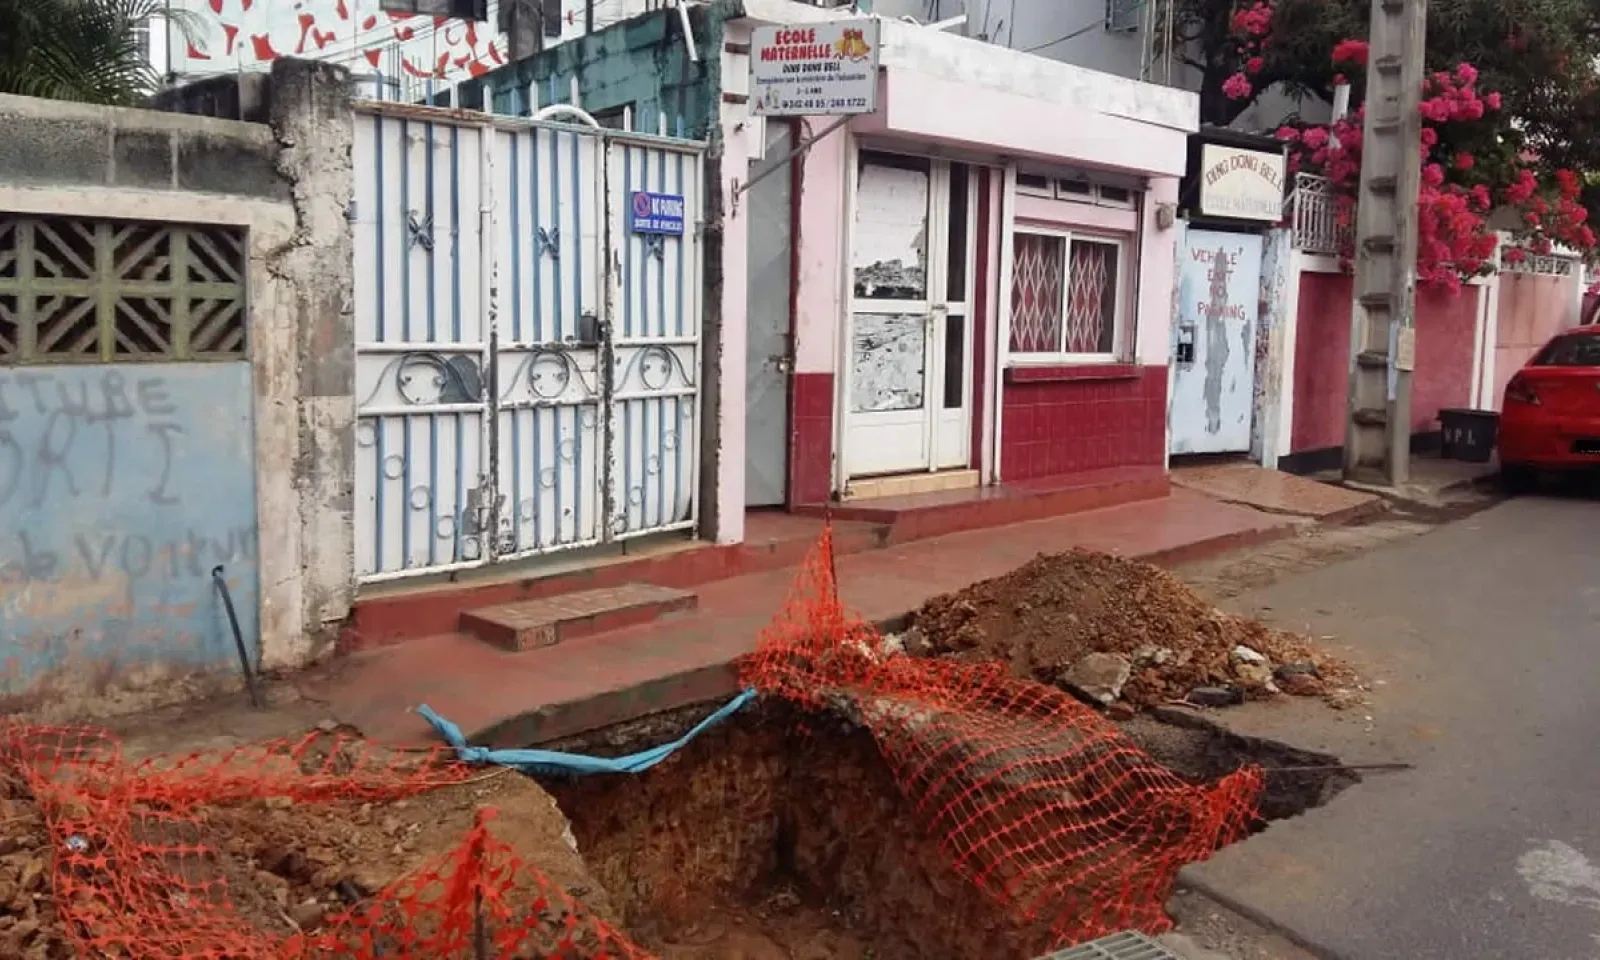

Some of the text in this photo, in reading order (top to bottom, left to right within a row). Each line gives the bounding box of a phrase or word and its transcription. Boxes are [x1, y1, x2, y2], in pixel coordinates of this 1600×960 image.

[775, 28, 815, 45] ECOLE
[760, 44, 831, 61] MATERNELLE
[1206, 155, 1283, 193] DING DONG BELL
[1192, 247, 1238, 265] VEHLE
